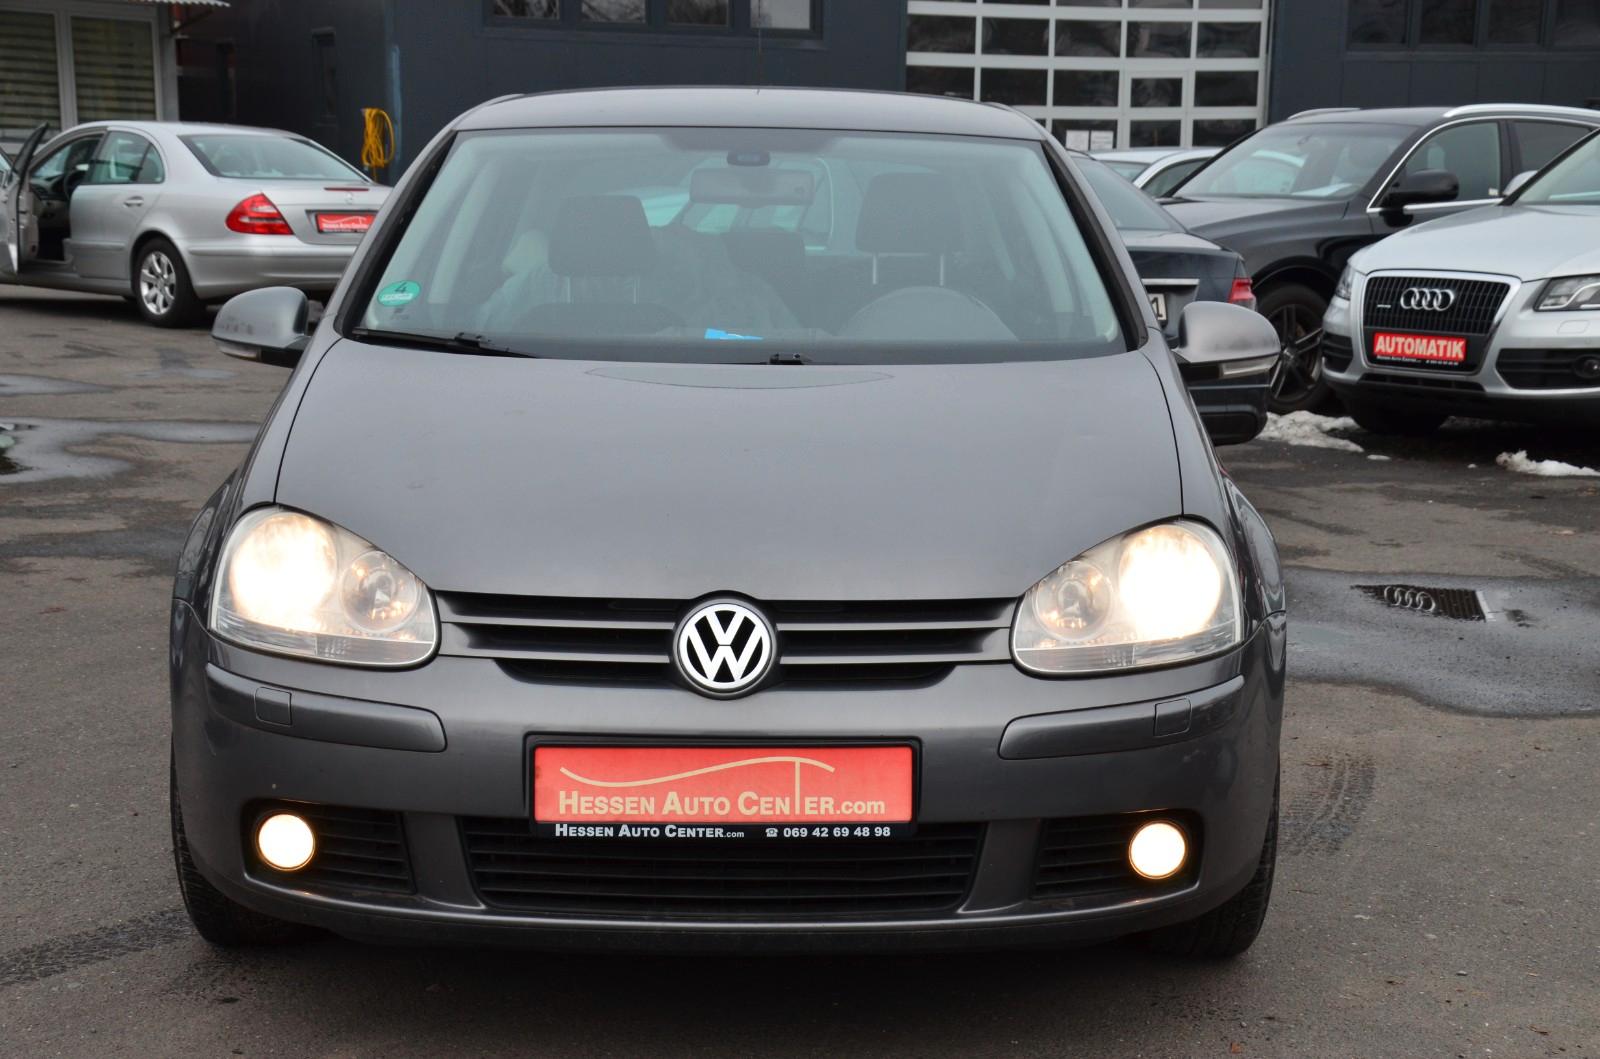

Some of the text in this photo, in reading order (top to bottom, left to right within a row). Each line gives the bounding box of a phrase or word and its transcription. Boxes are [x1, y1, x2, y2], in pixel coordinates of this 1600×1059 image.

[1375, 335, 1465, 358] AUTOMATIK
[558, 790, 655, 815] HESSEN
[662, 791, 731, 816] AUTO
[555, 823, 614, 837] HESSEN
[618, 824, 660, 838] AUTO
[783, 827, 808, 838] 069
[812, 827, 829, 838] 42
[833, 827, 849, 838] 69
[853, 827, 870, 838] 48
[874, 826, 891, 837] 98
